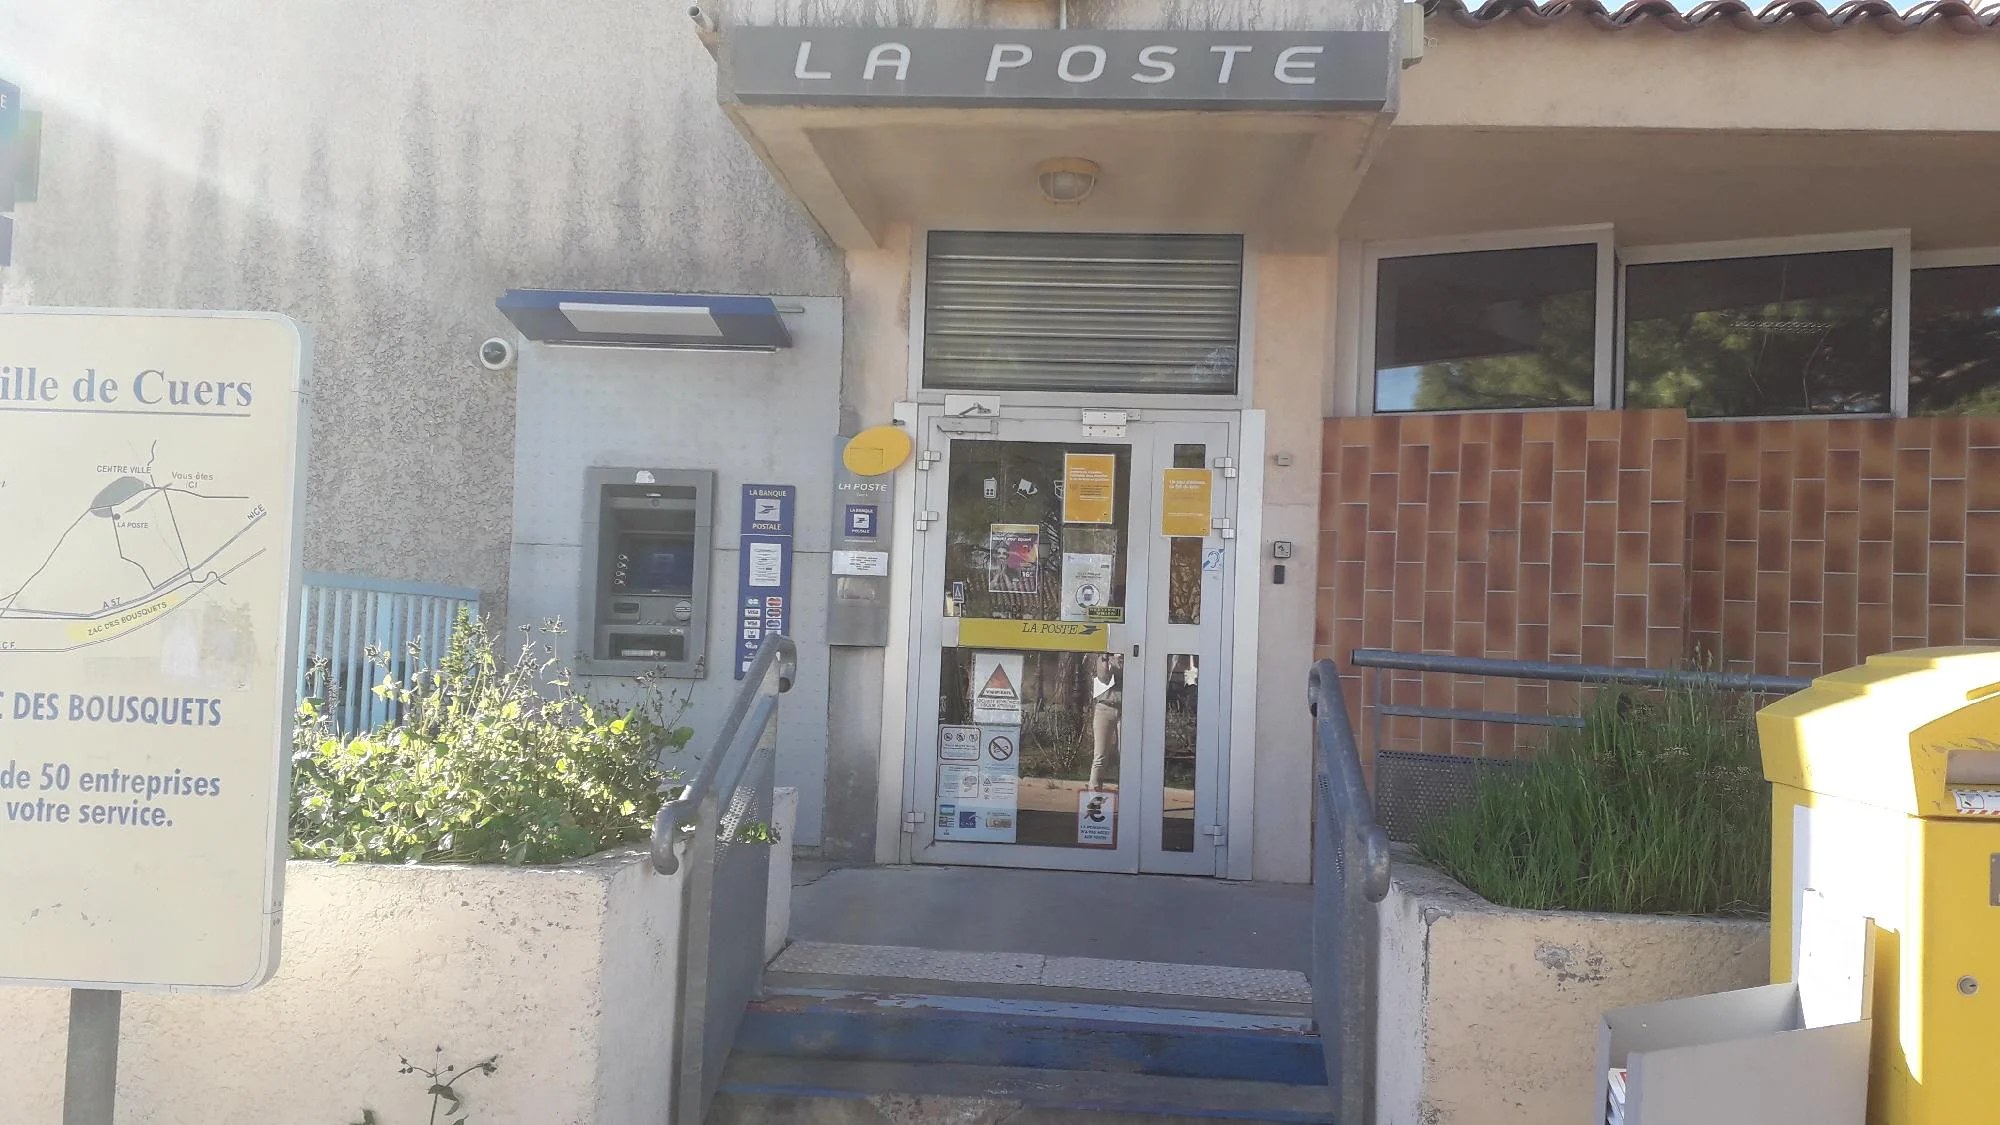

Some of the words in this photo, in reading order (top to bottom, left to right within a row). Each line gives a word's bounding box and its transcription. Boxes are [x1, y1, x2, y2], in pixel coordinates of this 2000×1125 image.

[794, 40, 911, 81] LA
[985, 43, 1325, 85] POSTE
[0, 366, 59, 402] ille
[72, 369, 119, 402] de
[132, 369, 253, 407] Cuers
[96, 465, 127, 473] CENTRE
[129, 466, 152, 474] VILLE
[171, 471, 193, 480] Vous
[758, 489, 787, 498] BANQUE
[838, 482, 851, 490] LA
[853, 483, 888, 492] POSTE
[752, 523, 782, 531] POSTALE
[121, 601, 168, 624] BOUSQUETS
[1021, 622, 1037, 633] LA
[1040, 623, 1079, 635] POSTE
[13, 691, 60, 721] DES
[68, 694, 222, 727] BOUSQUETS
[0, 759, 31, 790] de
[39, 763, 71, 792] 50
[79, 768, 221, 801] entreprises
[7, 797, 71, 823] votre
[78, 799, 174, 828] service.
